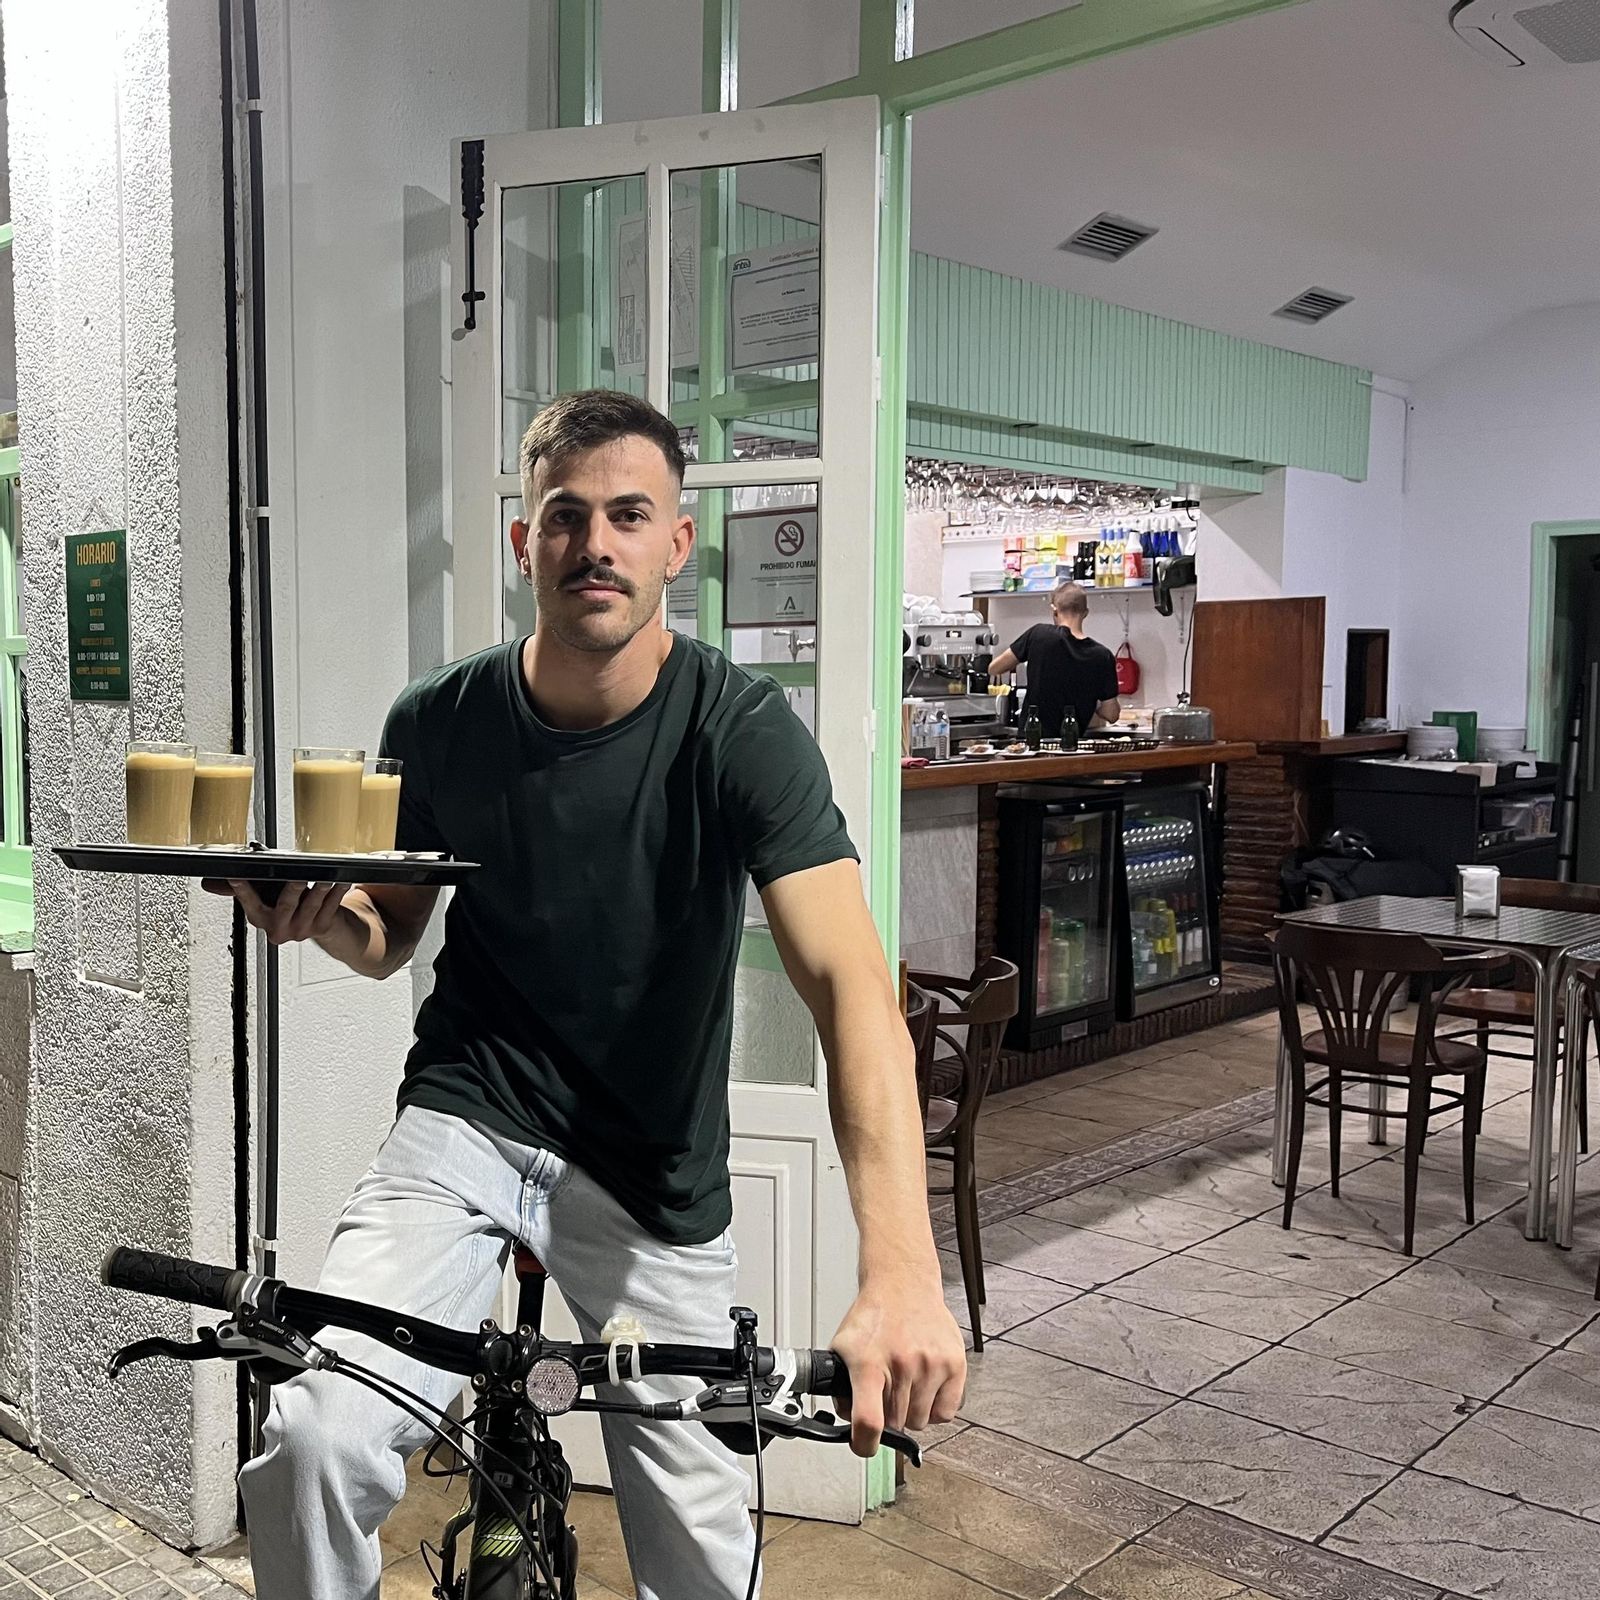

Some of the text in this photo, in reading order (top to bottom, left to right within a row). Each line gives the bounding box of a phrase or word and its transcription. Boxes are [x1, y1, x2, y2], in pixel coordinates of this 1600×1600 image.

[76, 541, 116, 566] HORARIO
[760, 559, 816, 571] PROHIBIDO FUMA
